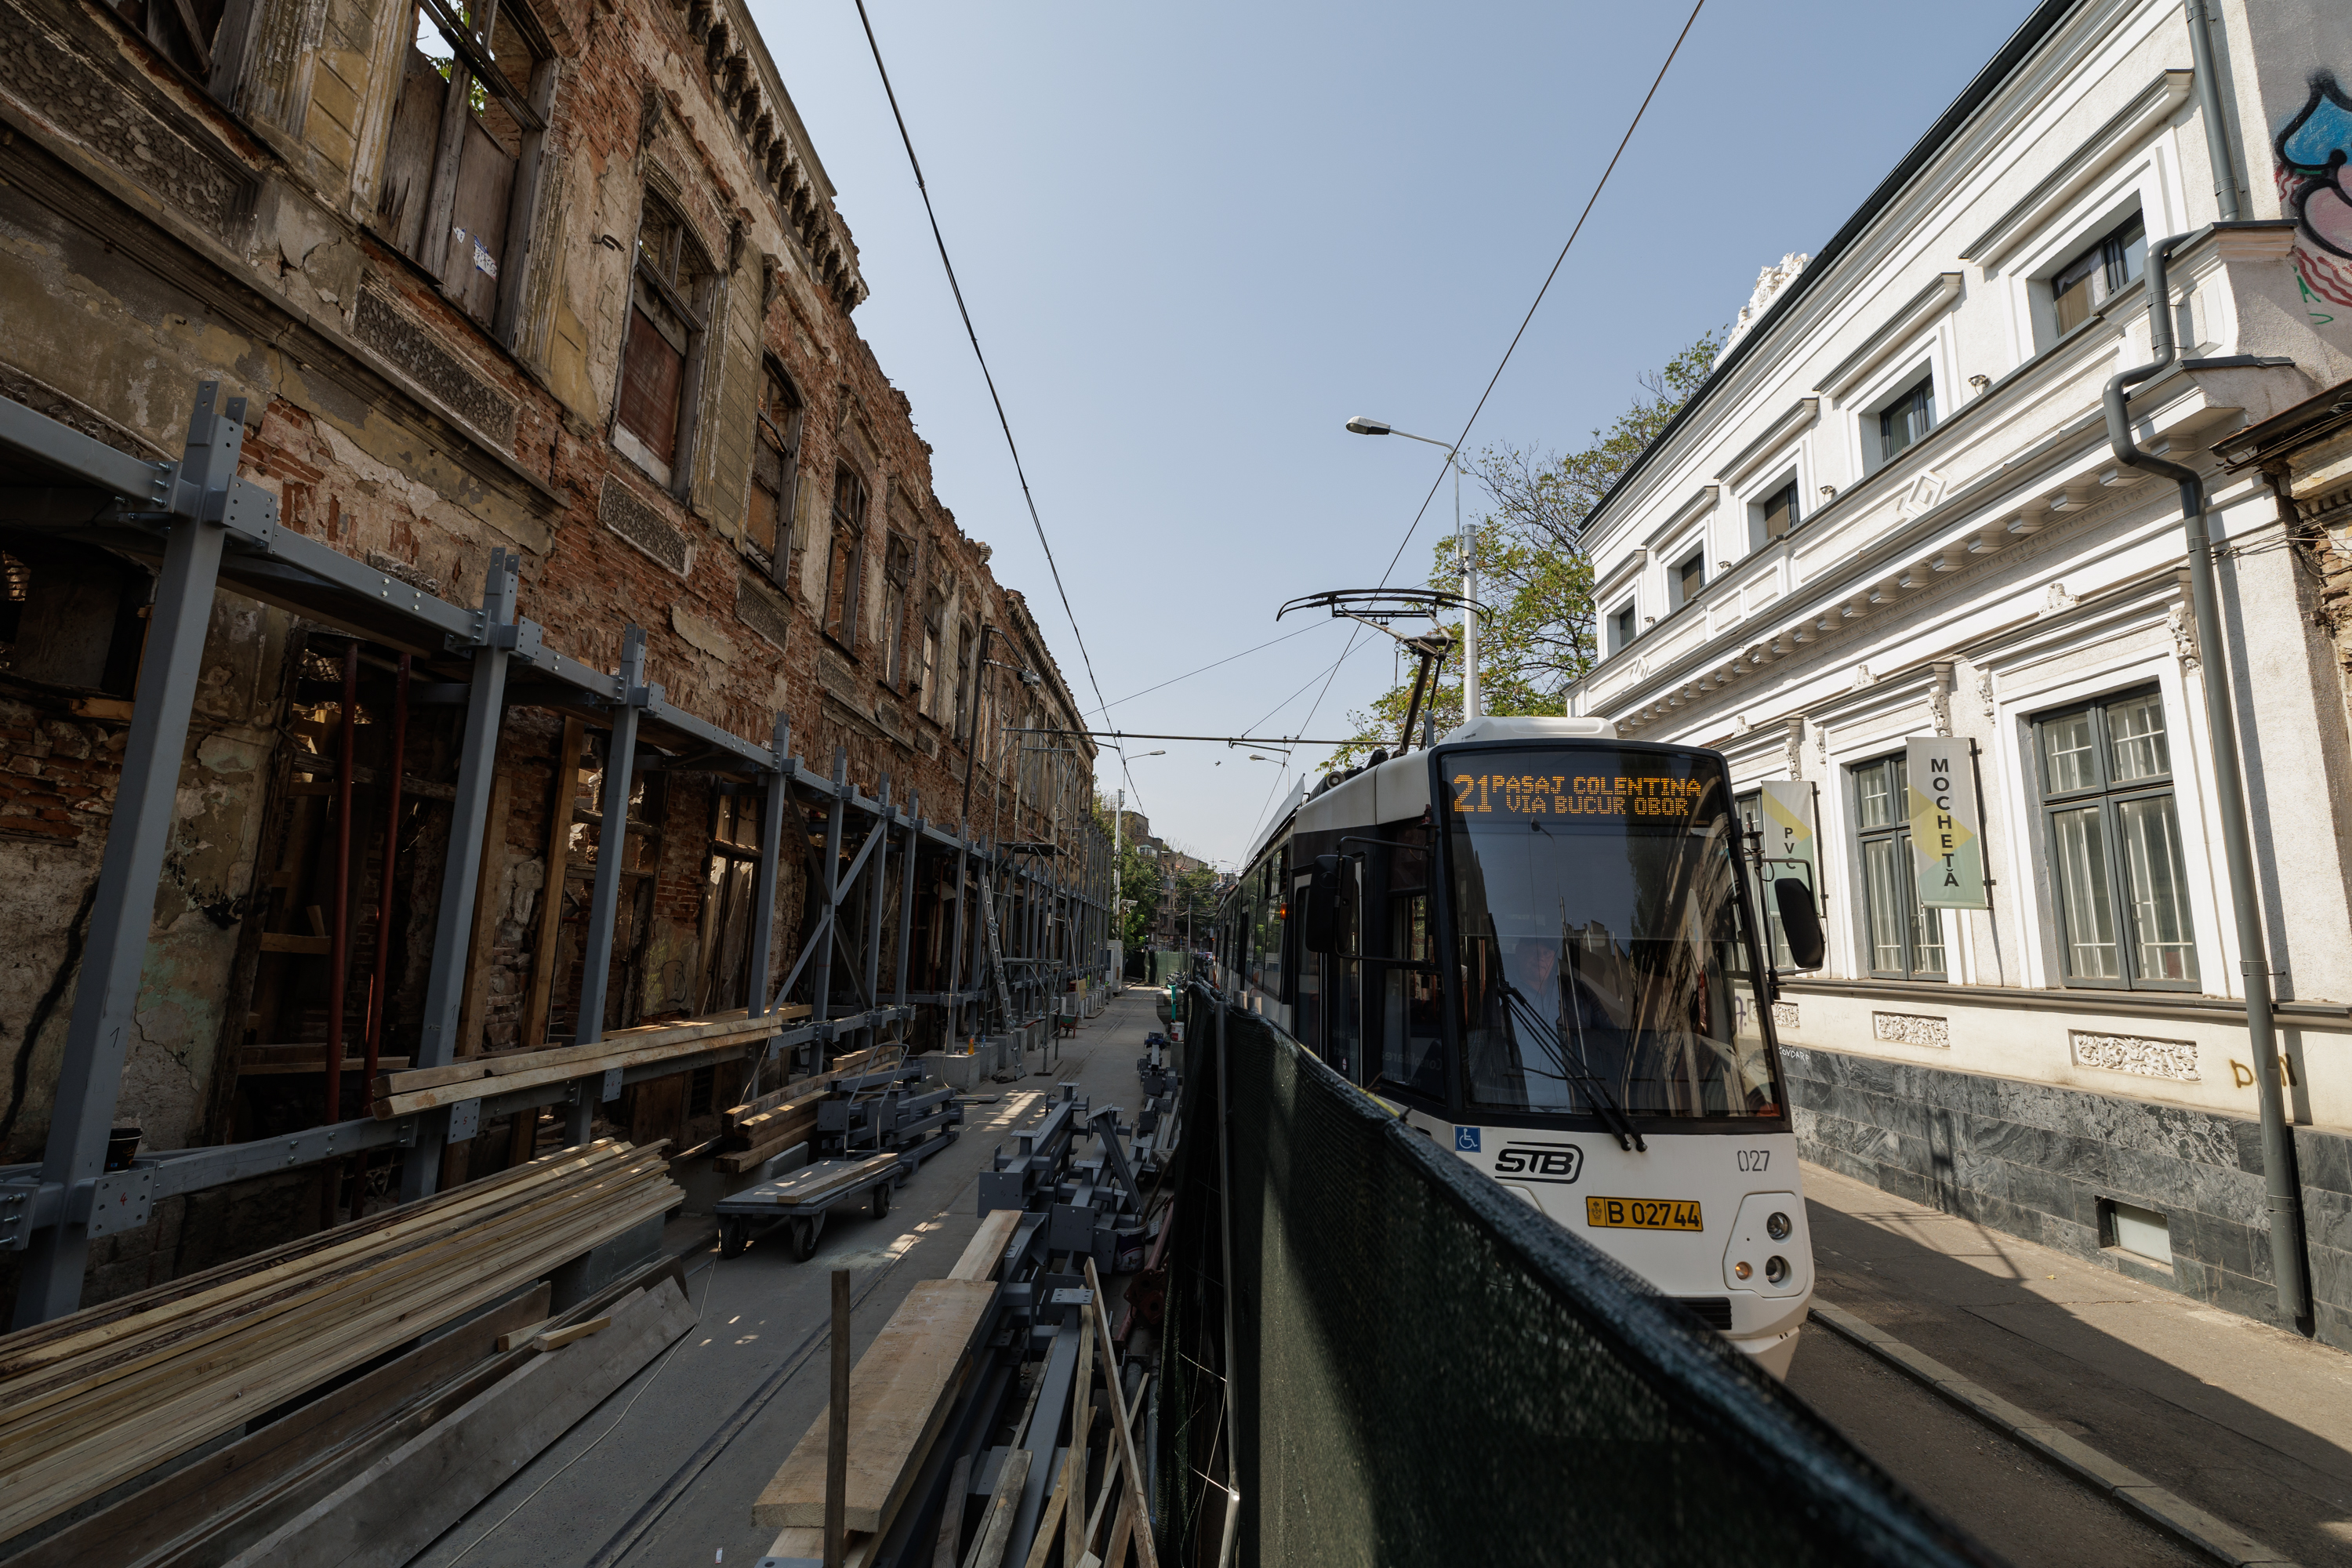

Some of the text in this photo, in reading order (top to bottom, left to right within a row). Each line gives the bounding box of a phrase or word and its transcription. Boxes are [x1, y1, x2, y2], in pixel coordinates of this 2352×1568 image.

[1454, 774, 1492, 812] 21
[1492, 775, 1702, 797] PASAJ COLENTINA
[1505, 795, 1690, 816] VIA BUCUR OBOR
[1930, 757, 1960, 887] MOCHETĂ
[109, 1026, 120, 1048] 1
[1494, 1149, 1575, 1175] STB
[1737, 1149, 1771, 1172] 027
[120, 1192, 127, 1206] 4
[1608, 1200, 1700, 1229] B 02744
